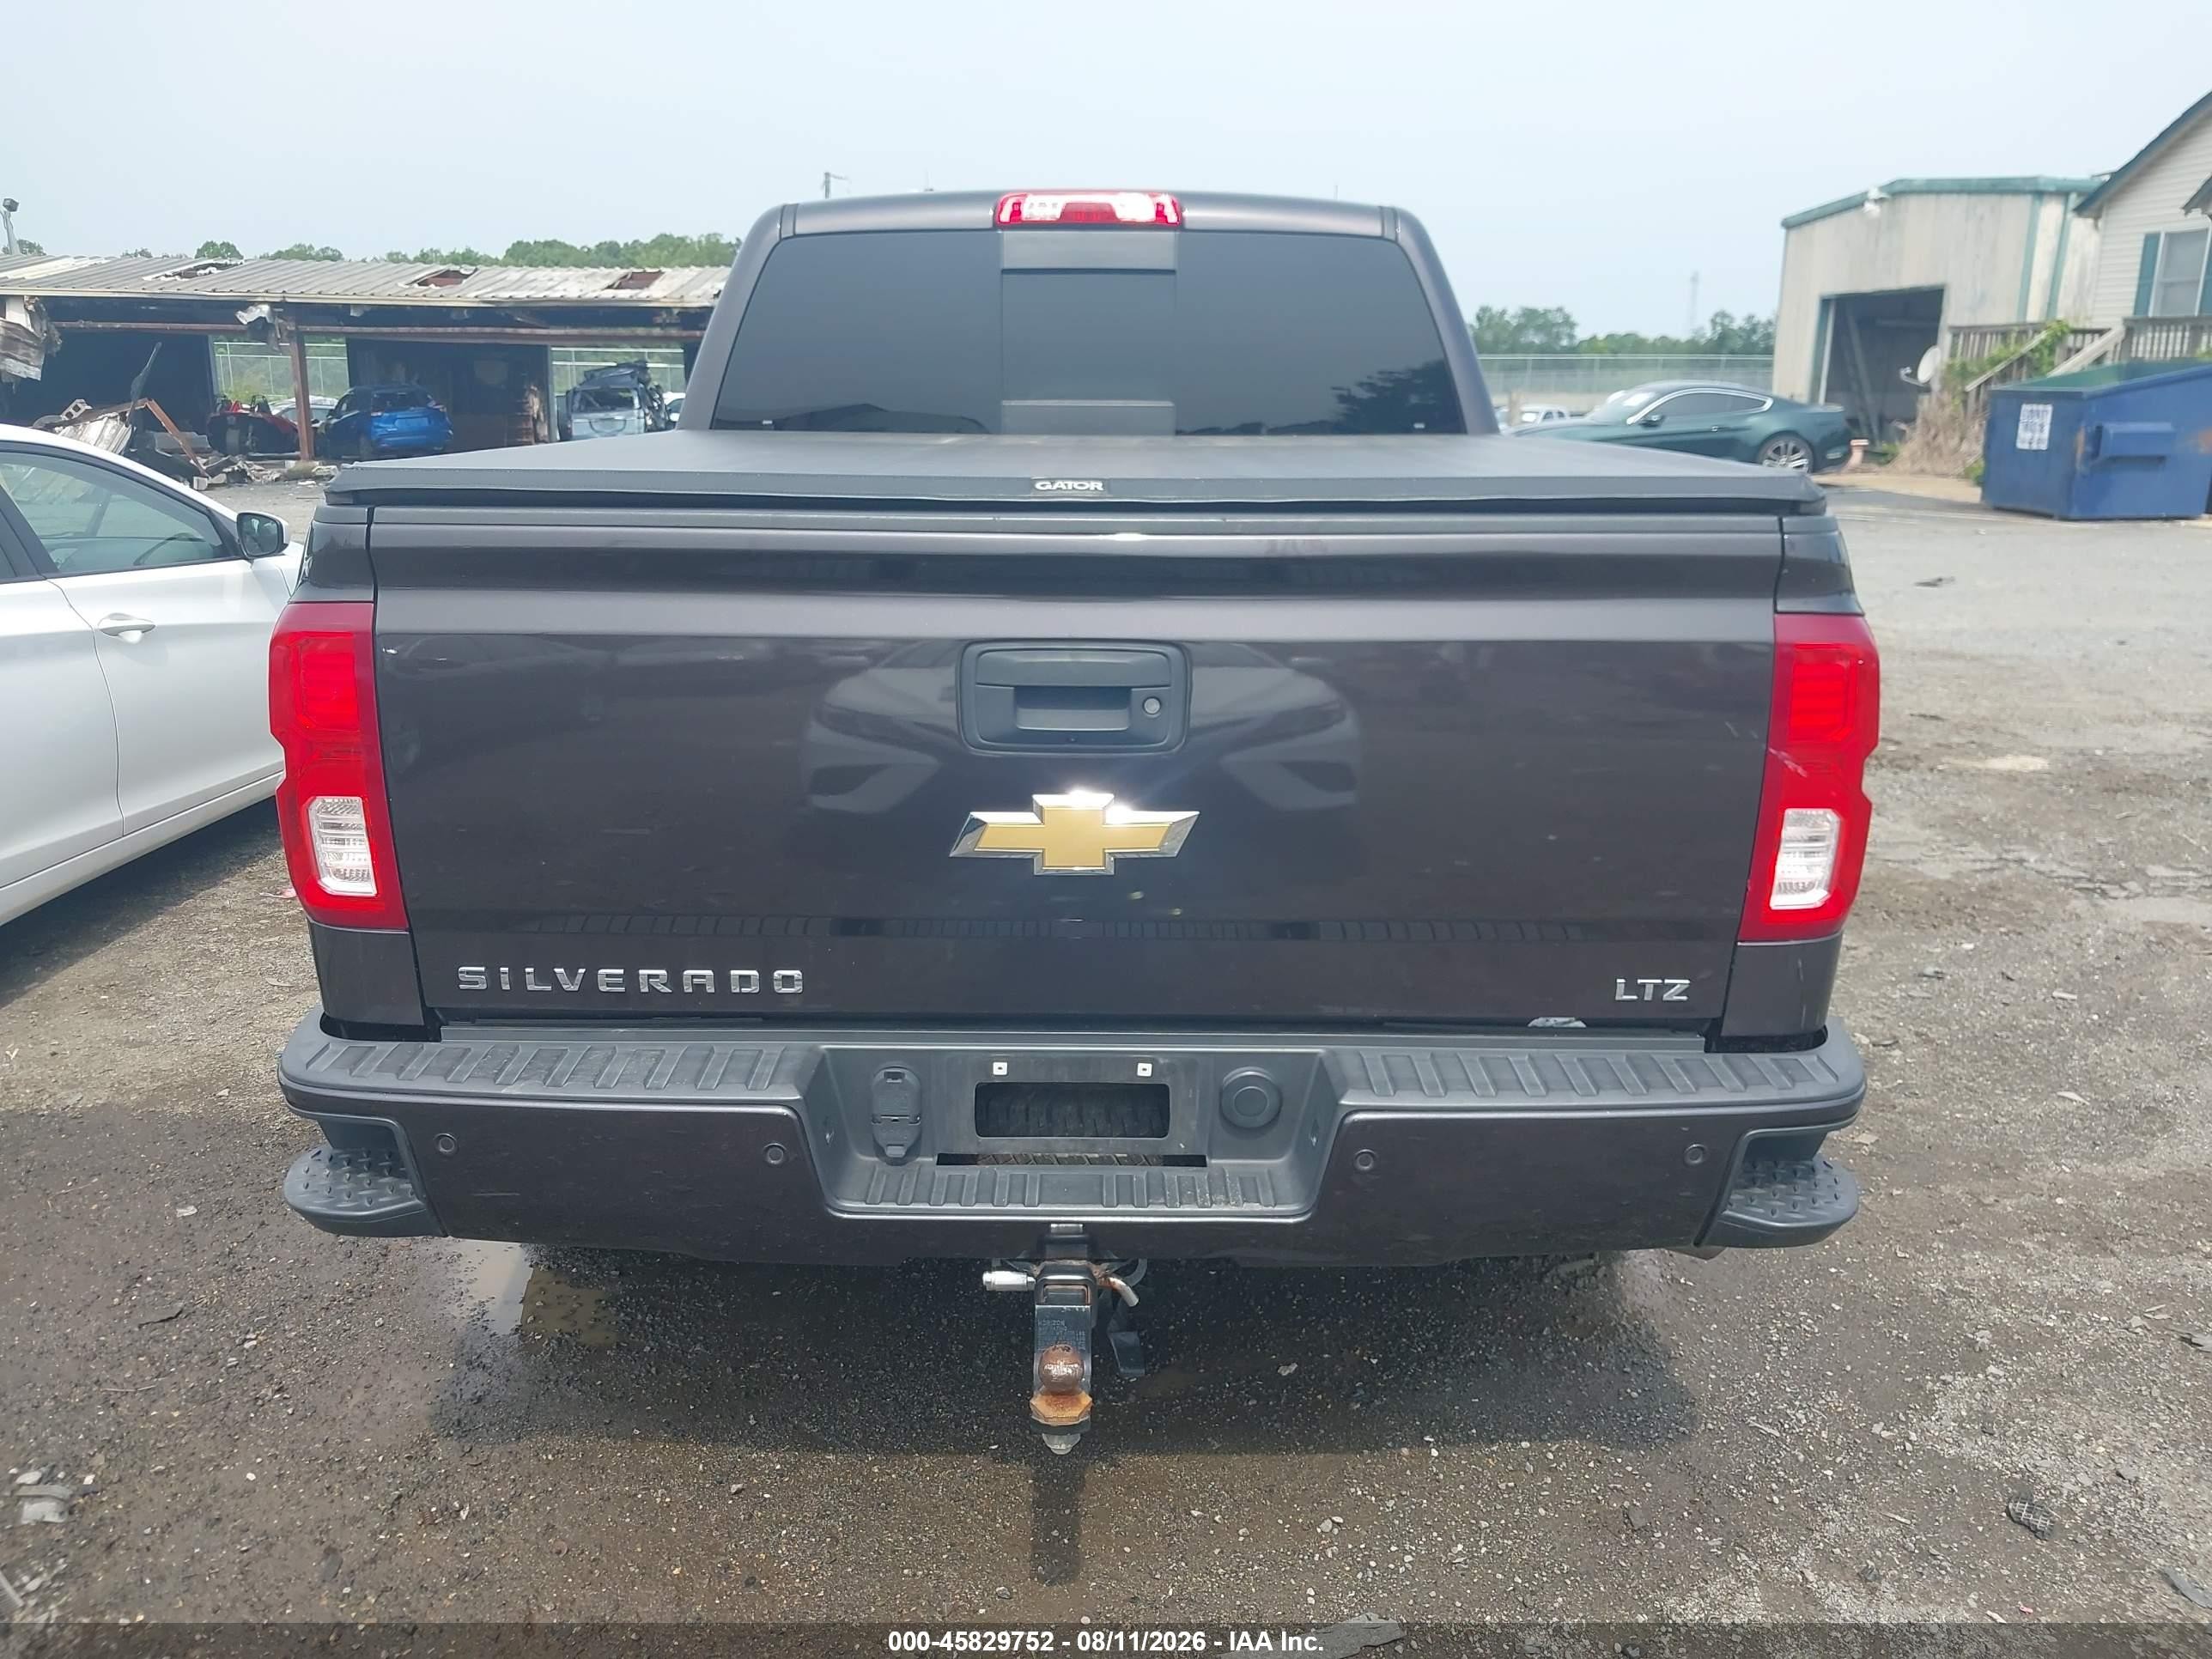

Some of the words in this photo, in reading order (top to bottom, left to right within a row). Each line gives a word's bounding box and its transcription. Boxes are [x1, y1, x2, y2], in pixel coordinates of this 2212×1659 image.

[1035, 480, 1104, 491] GATOR
[458, 966, 804, 994] SILVERADO
[1615, 979, 1691, 1001] LTZ
